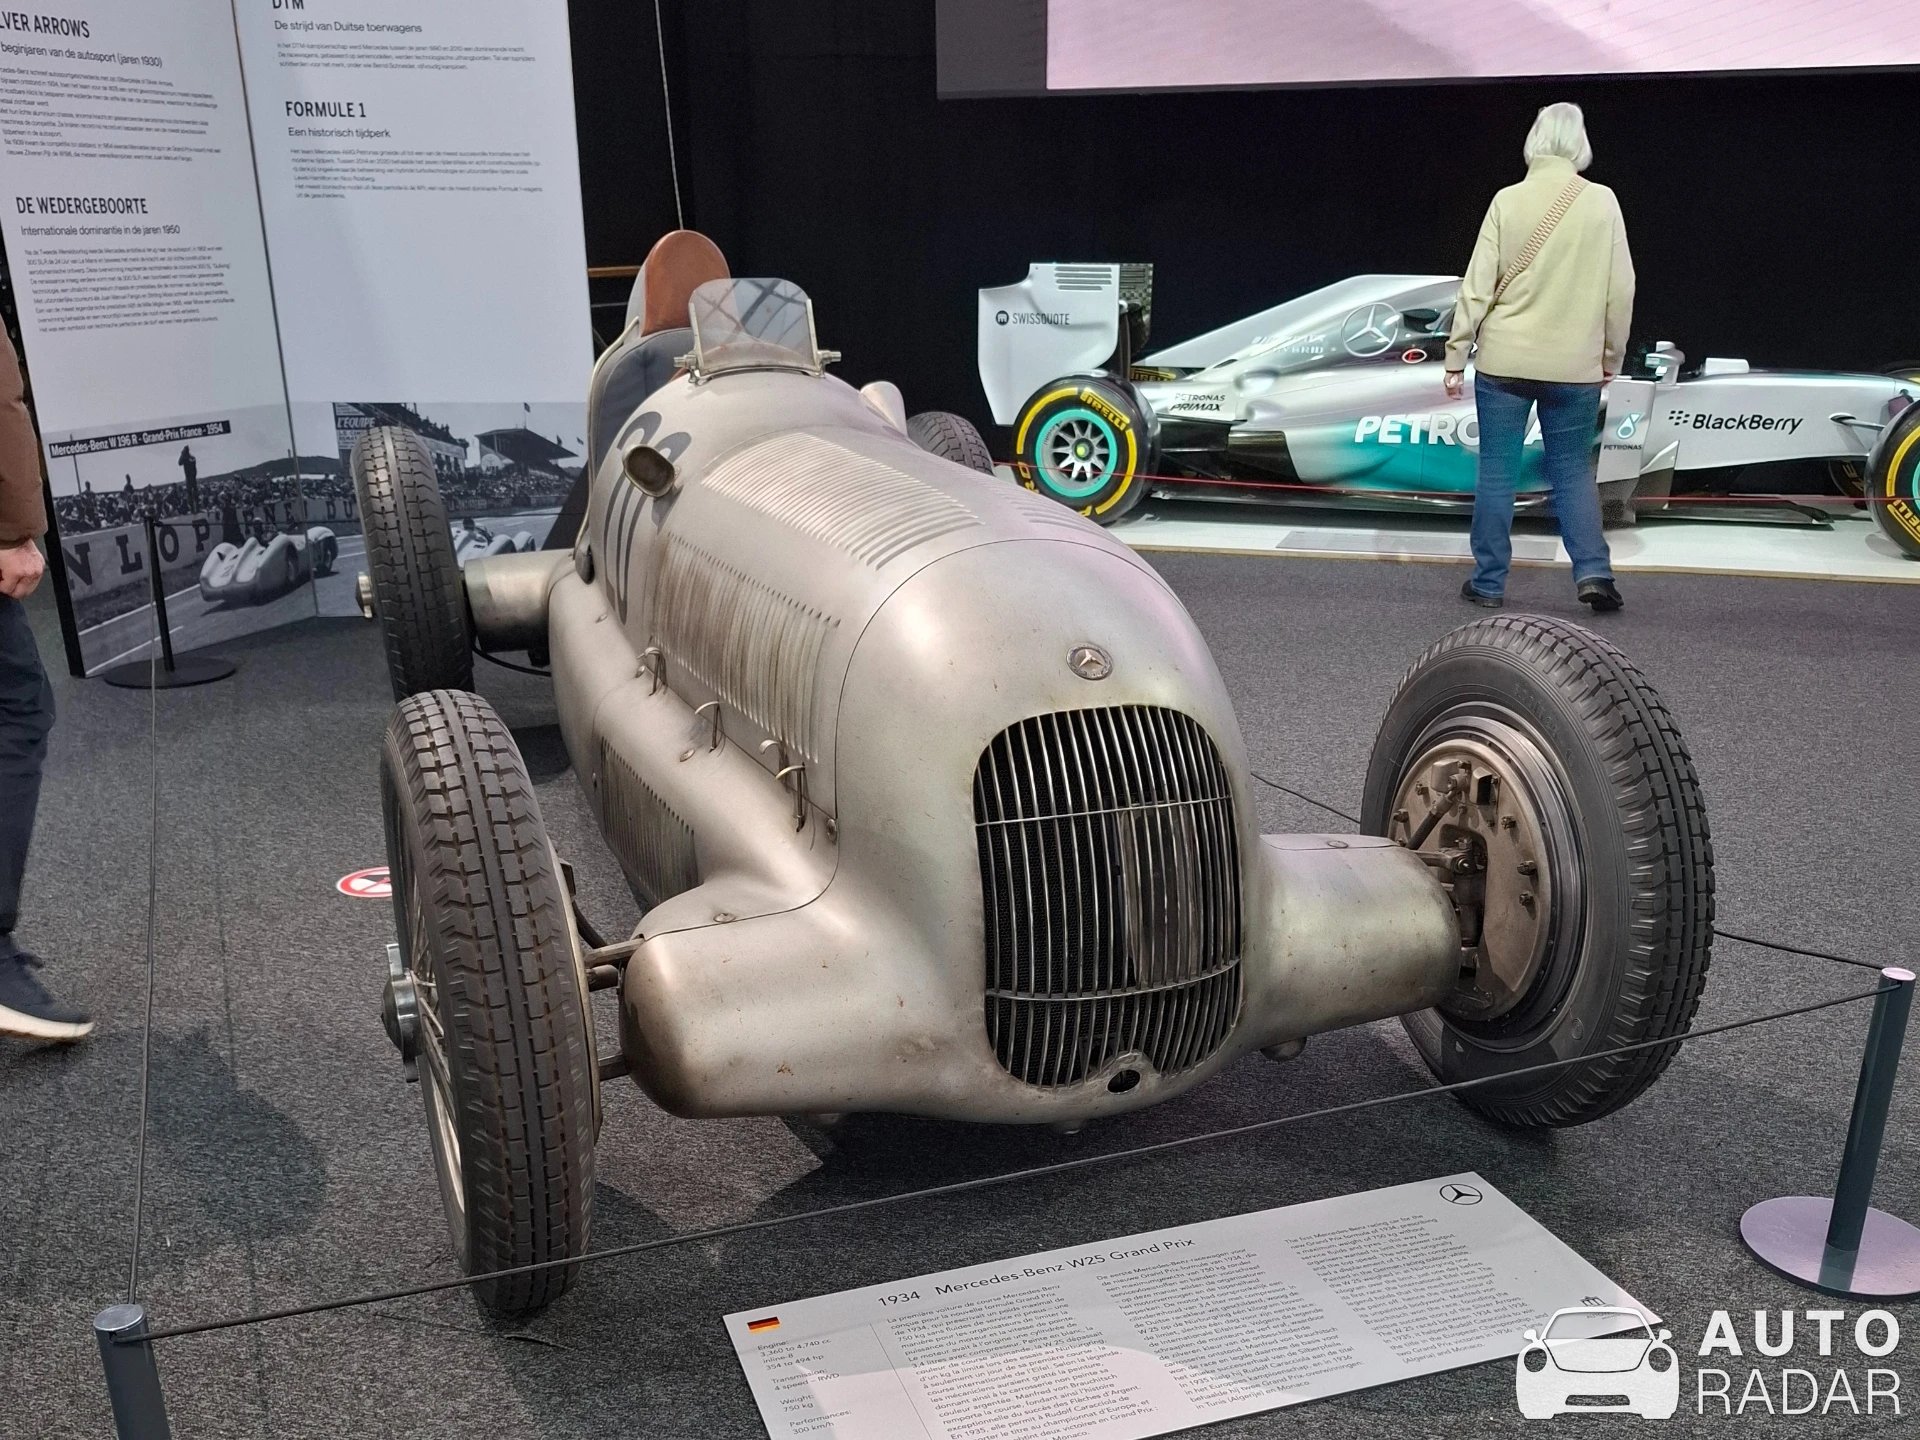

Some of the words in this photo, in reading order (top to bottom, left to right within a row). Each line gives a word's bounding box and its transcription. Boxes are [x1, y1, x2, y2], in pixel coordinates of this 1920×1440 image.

[34, 15, 90, 38] ARROWS
[274, 20, 288, 30] De
[290, 21, 314, 32] strijd
[315, 23, 332, 31] van
[334, 21, 364, 32] Duitse
[366, 23, 422, 33] toerwagens
[0, 42, 46, 57] beginjaren
[50, 49, 64, 58] van
[64, 48, 76, 58] de
[77, 51, 117, 63] autosport
[118, 52, 140, 66] (jaren
[141, 56, 163, 68] 1930)
[285, 101, 356, 118] FORMULE
[359, 102, 366, 118] 1
[288, 127, 306, 136] Een
[308, 128, 354, 138] historisch
[355, 128, 391, 138] tijdperk
[16, 197, 35, 214] DE
[36, 197, 148, 214] WEDERGEBOORTE
[20, 226, 78, 236] Internationale
[79, 225, 122, 235] dominantie
[124, 226, 131, 234] in
[132, 225, 142, 234] de
[142, 226, 162, 236] jaren
[162, 224, 180, 234] 1950
[1012, 312, 1070, 326] SWISSQUOTE
[1174, 393, 1226, 402] PETRONAS
[1079, 387, 1130, 431] PIRELLI
[1170, 403, 1222, 412] PRIMAX
[337, 416, 376, 428] L'EQUIPE
[1692, 414, 1804, 434] BlackBerry
[51, 439, 109, 456] Mercedes-Benz
[109, 438, 118, 448] W
[117, 436, 131, 447] 196
[132, 434, 138, 445] R
[142, 428, 180, 443] Grand-Prix
[180, 425, 202, 438] France
[206, 422, 224, 435] 1954
[878, 1291, 920, 1306] 1934
[935, 1264, 1064, 1295] Mercedes-Benz
[1066, 1254, 1105, 1268] W25
[1109, 1243, 1160, 1260] Grand
[1162, 1239, 1194, 1250] Prix
[898, 1310, 934, 1322] première
[935, 1304, 962, 1314] voiture
[976, 1296, 1001, 1305] course
[1002, 1284, 1060, 1300] Mercedes-Benz
[1415, 1320, 1438, 1329] raced
[1436, 1314, 1472, 1325] between
[1472, 1309, 1492, 1317] 1934
[1493, 1305, 1508, 1313] and
[1508, 1301, 1527, 1309] 1936.
[757, 1340, 788, 1351] Engine:
[761, 1347, 783, 1357] 3,360
[796, 1340, 820, 1349] 4,740
[763, 1352, 793, 1364] inline-8
[766, 1362, 781, 1370] 354
[795, 1356, 811, 1364] 494
[1189, 1376, 1209, 1386] 1935
[1209, 1373, 1231, 1381] hielp
[1230, 1369, 1243, 1377] hij
[1242, 1363, 1269, 1375] Rudolf
[1269, 1355, 1310, 1368] Caracciola
[1338, 1345, 1354, 1354] titel
[771, 1368, 827, 1384] Transmission:
[782, 1379, 808, 1390] speed
[817, 1372, 839, 1382] RWD
[927, 1386, 954, 1396] course
[955, 1373, 1012, 1390] internationale
[1026, 1364, 1052, 1374] l'Eifel.
[1053, 1360, 1076, 1368] Selon
[1085, 1350, 1122, 1361] légende,
[1193, 1386, 1209, 1394] het
[1208, 1378, 1248, 1390] Europees
[1246, 1364, 1312, 1381] kampioenschap,
[1332, 1354, 1352, 1363] 1936
[935, 1398, 970, 1410] donnant
[972, 1393, 991, 1402] ainsi
[1009, 1380, 1053, 1394] carrosserie
[1054, 1376, 1070, 1384] non
[1071, 1371, 1098, 1381] peinte
[939, 1406, 970, 1418] couleur
[973, 1398, 1014, 1410] argentée.
[1015, 1387, 1051, 1400] Manfred
[1069, 1373, 1117, 1388] Brauchitsch
[1204, 1398, 1227, 1407] Tunis
[1227, 1390, 1264, 1403] (Algerije)
[1276, 1381, 1309, 1392] Monaco.
[779, 1394, 814, 1405] Weight:
[783, 1404, 800, 1412] 750
[942, 1412, 982, 1425] remporta
[993, 1404, 1024, 1414] course,
[1025, 1395, 1058, 1406] fondant
[1060, 1389, 1078, 1399] ainsi
[1078, 1383, 1114, 1394] l'histoire
[947, 1414, 1009, 1432] exceptionnelle
[1024, 1405, 1051, 1415] succès
[1069, 1394, 1101, 1405] Flèches
[1102, 1385, 1141, 1397] d'Argent.
[789, 1410, 851, 1427] Performances:
[964, 1426, 989, 1437] 1935,
[990, 1423, 1006, 1431] elle
[1008, 1416, 1036, 1428] permit
[1044, 1406, 1072, 1418] Rudolf
[1073, 1398, 1117, 1412] Caracciola
[792, 1426, 809, 1435] 300
[811, 1421, 834, 1430] km/h
